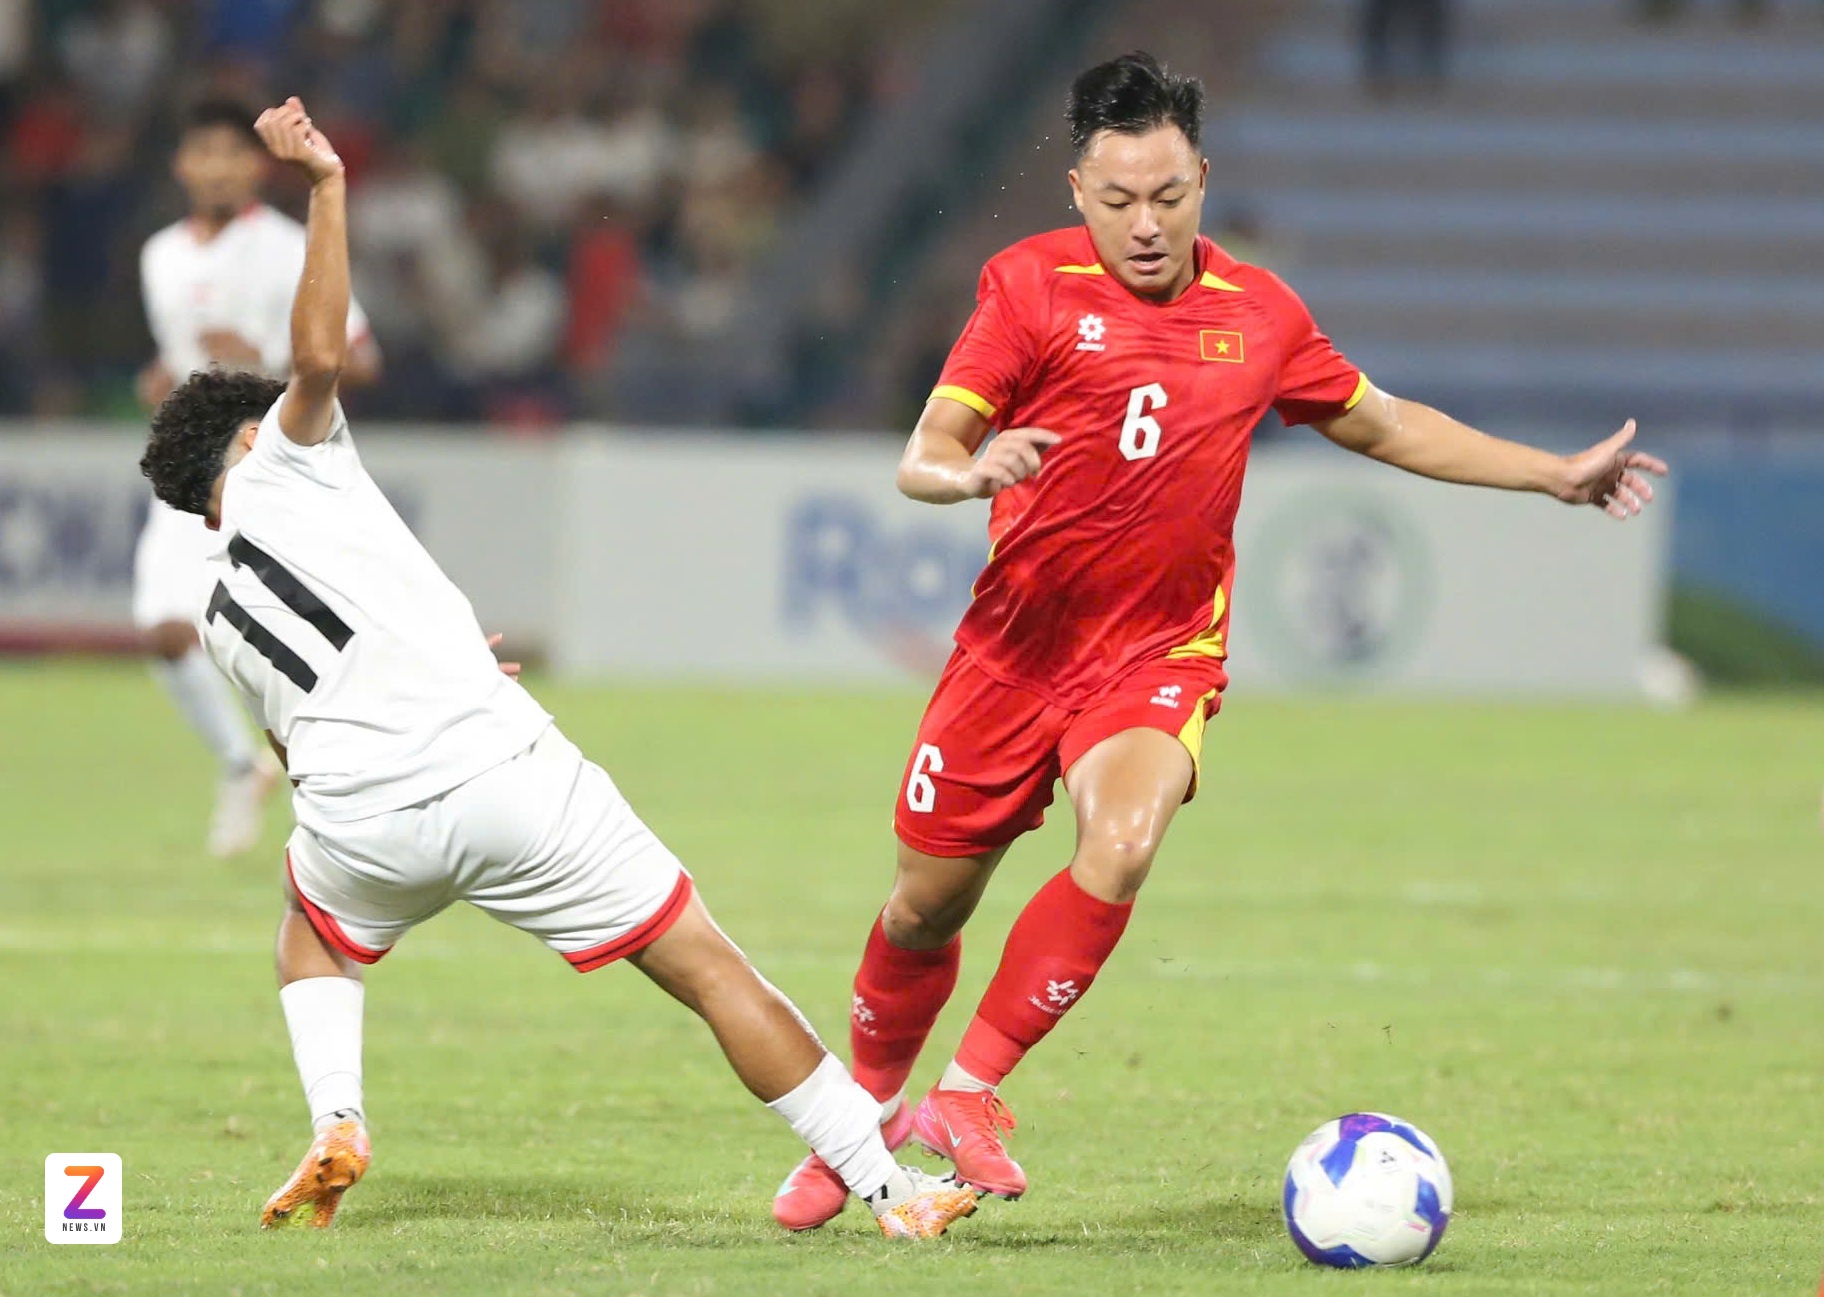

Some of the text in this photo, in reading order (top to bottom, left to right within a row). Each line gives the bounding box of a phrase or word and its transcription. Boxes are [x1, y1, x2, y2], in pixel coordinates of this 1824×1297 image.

[1118, 382, 1168, 461] 6
[206, 532, 355, 694] 11
[906, 742, 944, 813] 6
